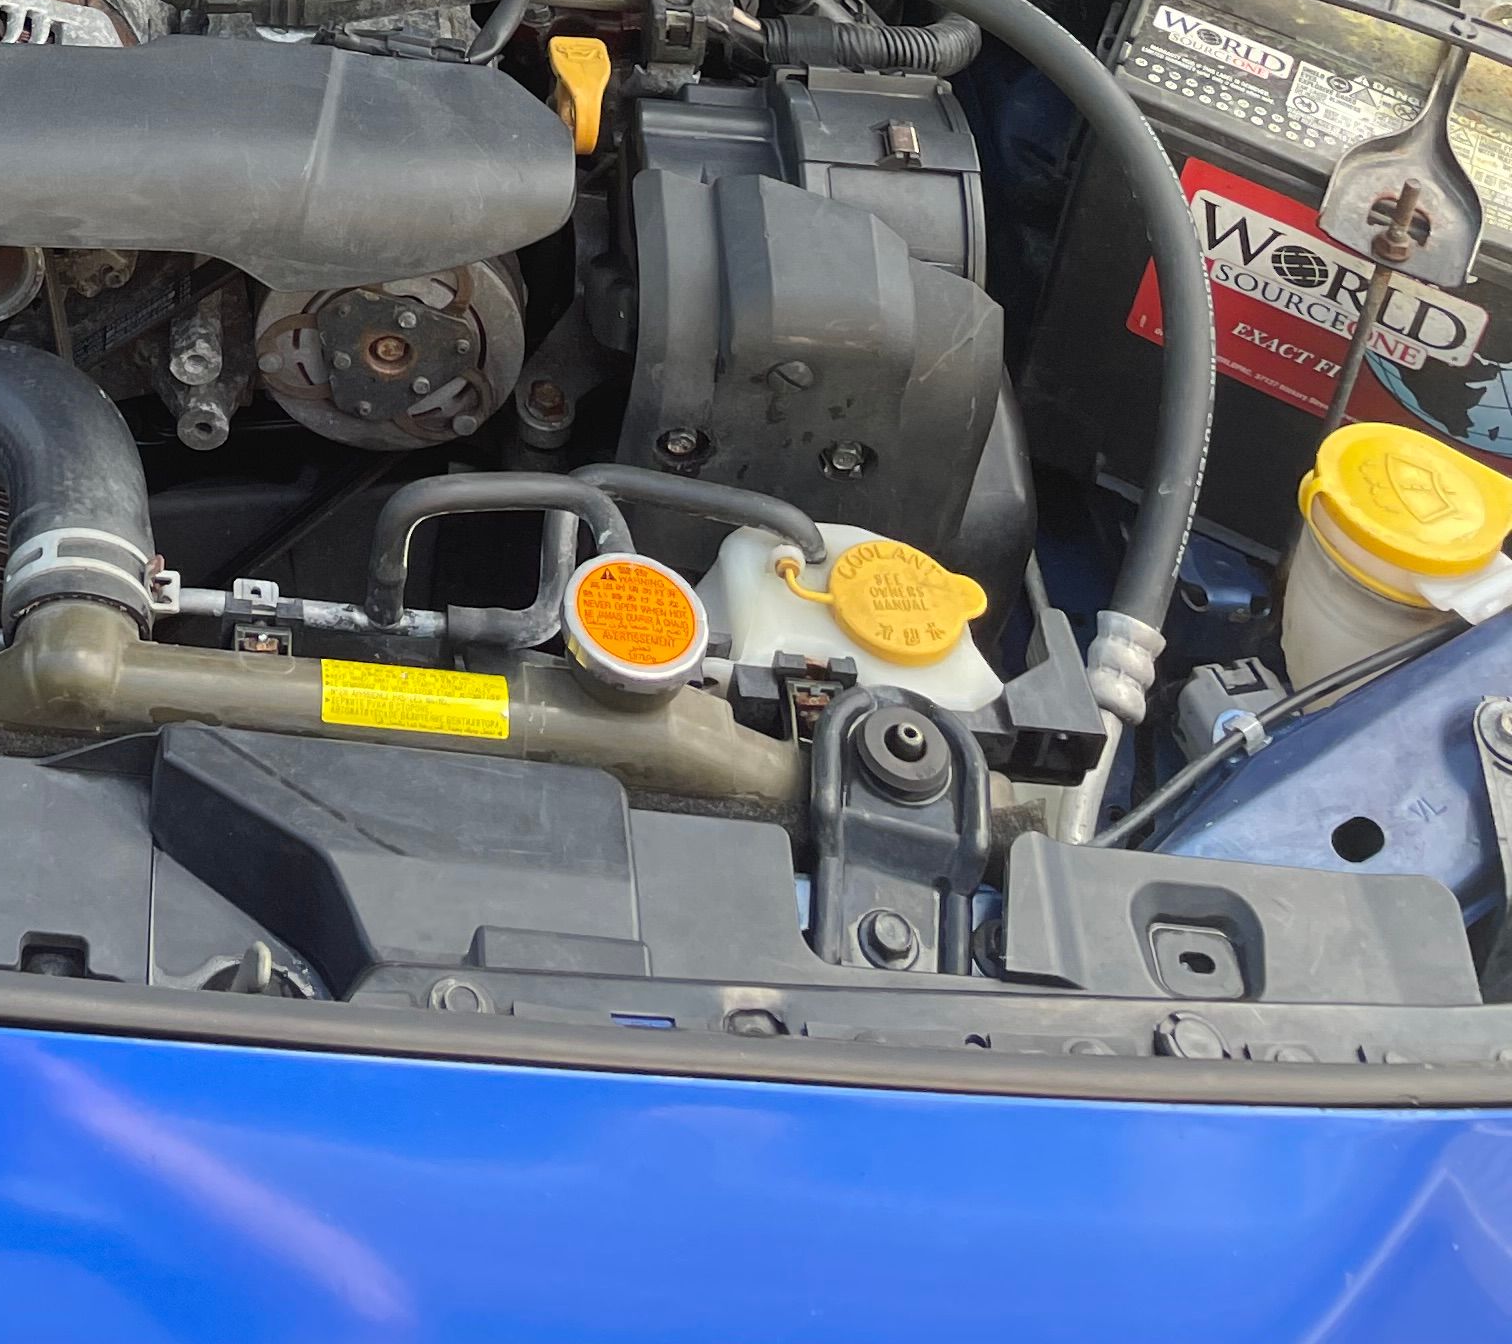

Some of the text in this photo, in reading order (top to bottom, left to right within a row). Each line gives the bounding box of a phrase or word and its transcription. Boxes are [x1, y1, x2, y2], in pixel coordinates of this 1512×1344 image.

[1164, 10, 1285, 72] WORLD
[1372, 80, 1424, 110] DANG
[1200, 197, 1467, 350] WORLD
[1231, 321, 1343, 379] EXACT FI
[837, 543, 943, 581] COOLANT
[873, 573, 902, 585] SEE
[872, 599, 928, 612] MANUAL
